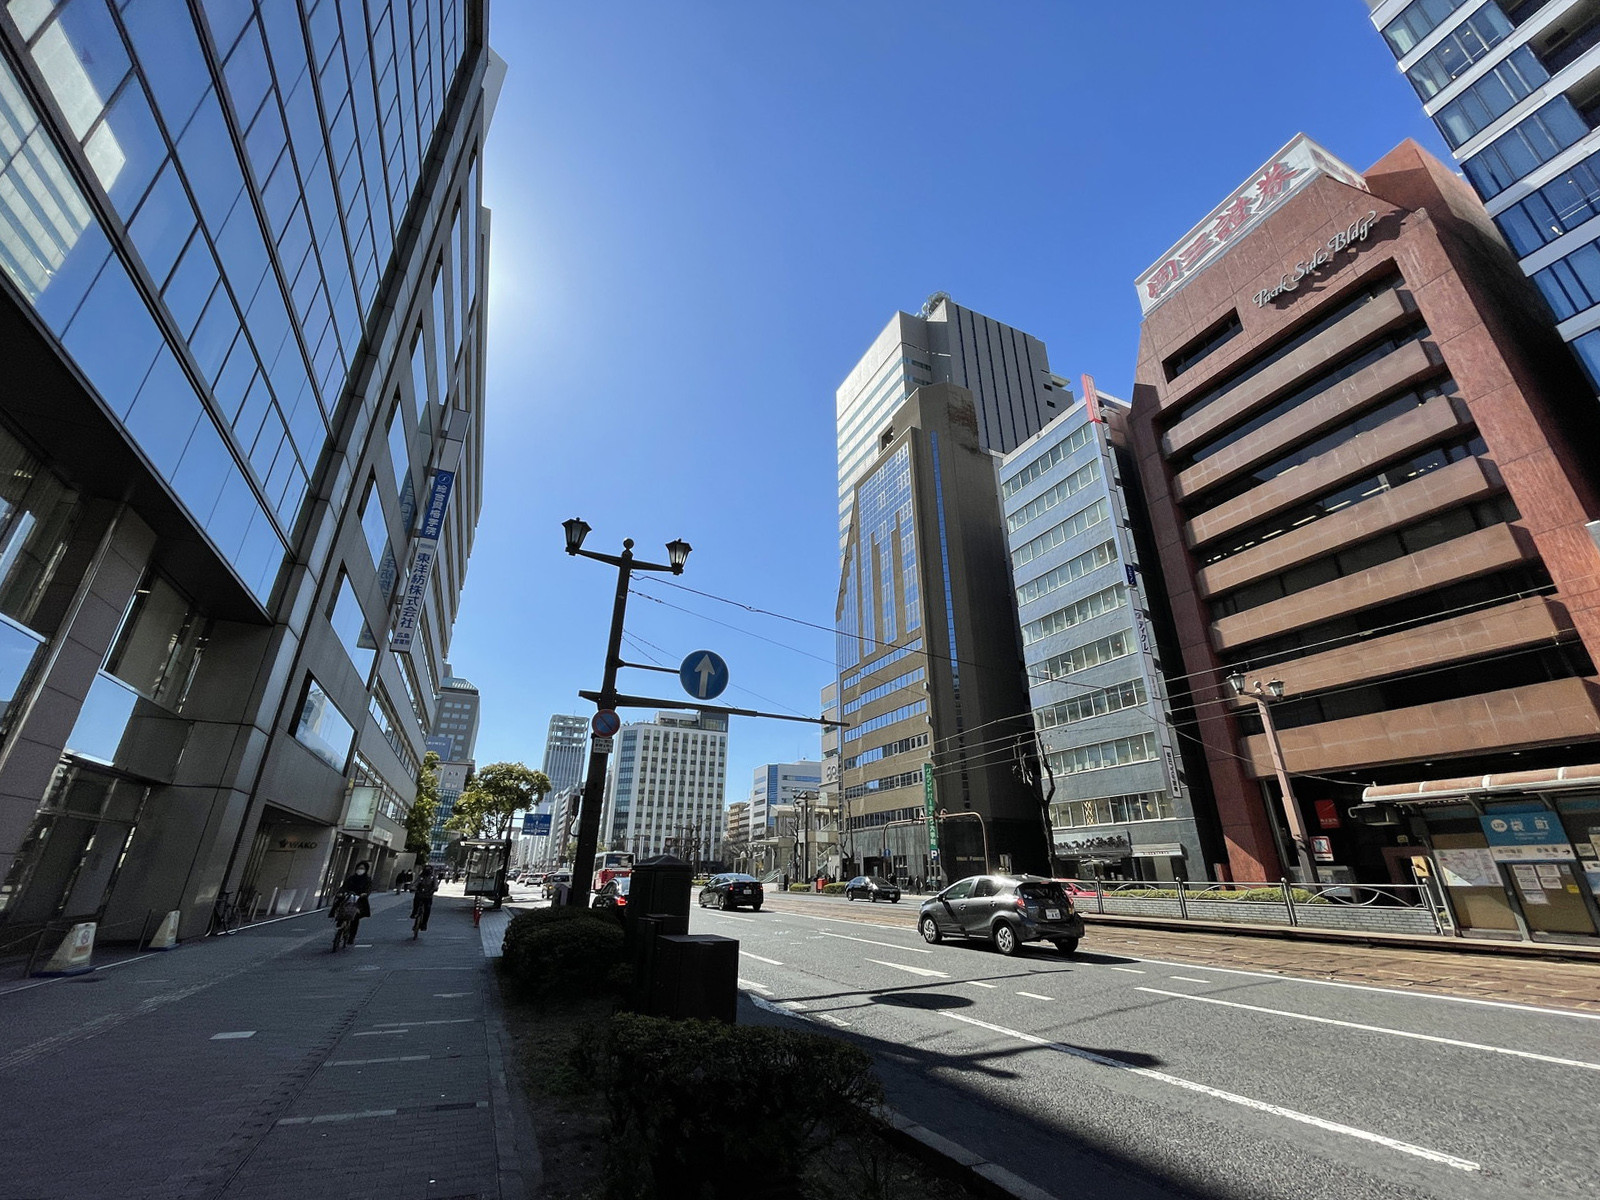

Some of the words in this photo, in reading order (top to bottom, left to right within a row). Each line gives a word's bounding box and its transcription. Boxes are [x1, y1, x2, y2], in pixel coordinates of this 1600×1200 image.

[1252, 272, 1298, 308] Park
[1291, 248, 1329, 283] Side
[399, 552, 431, 630] 東洋紡株式会社
[930, 850, 938, 859] P
